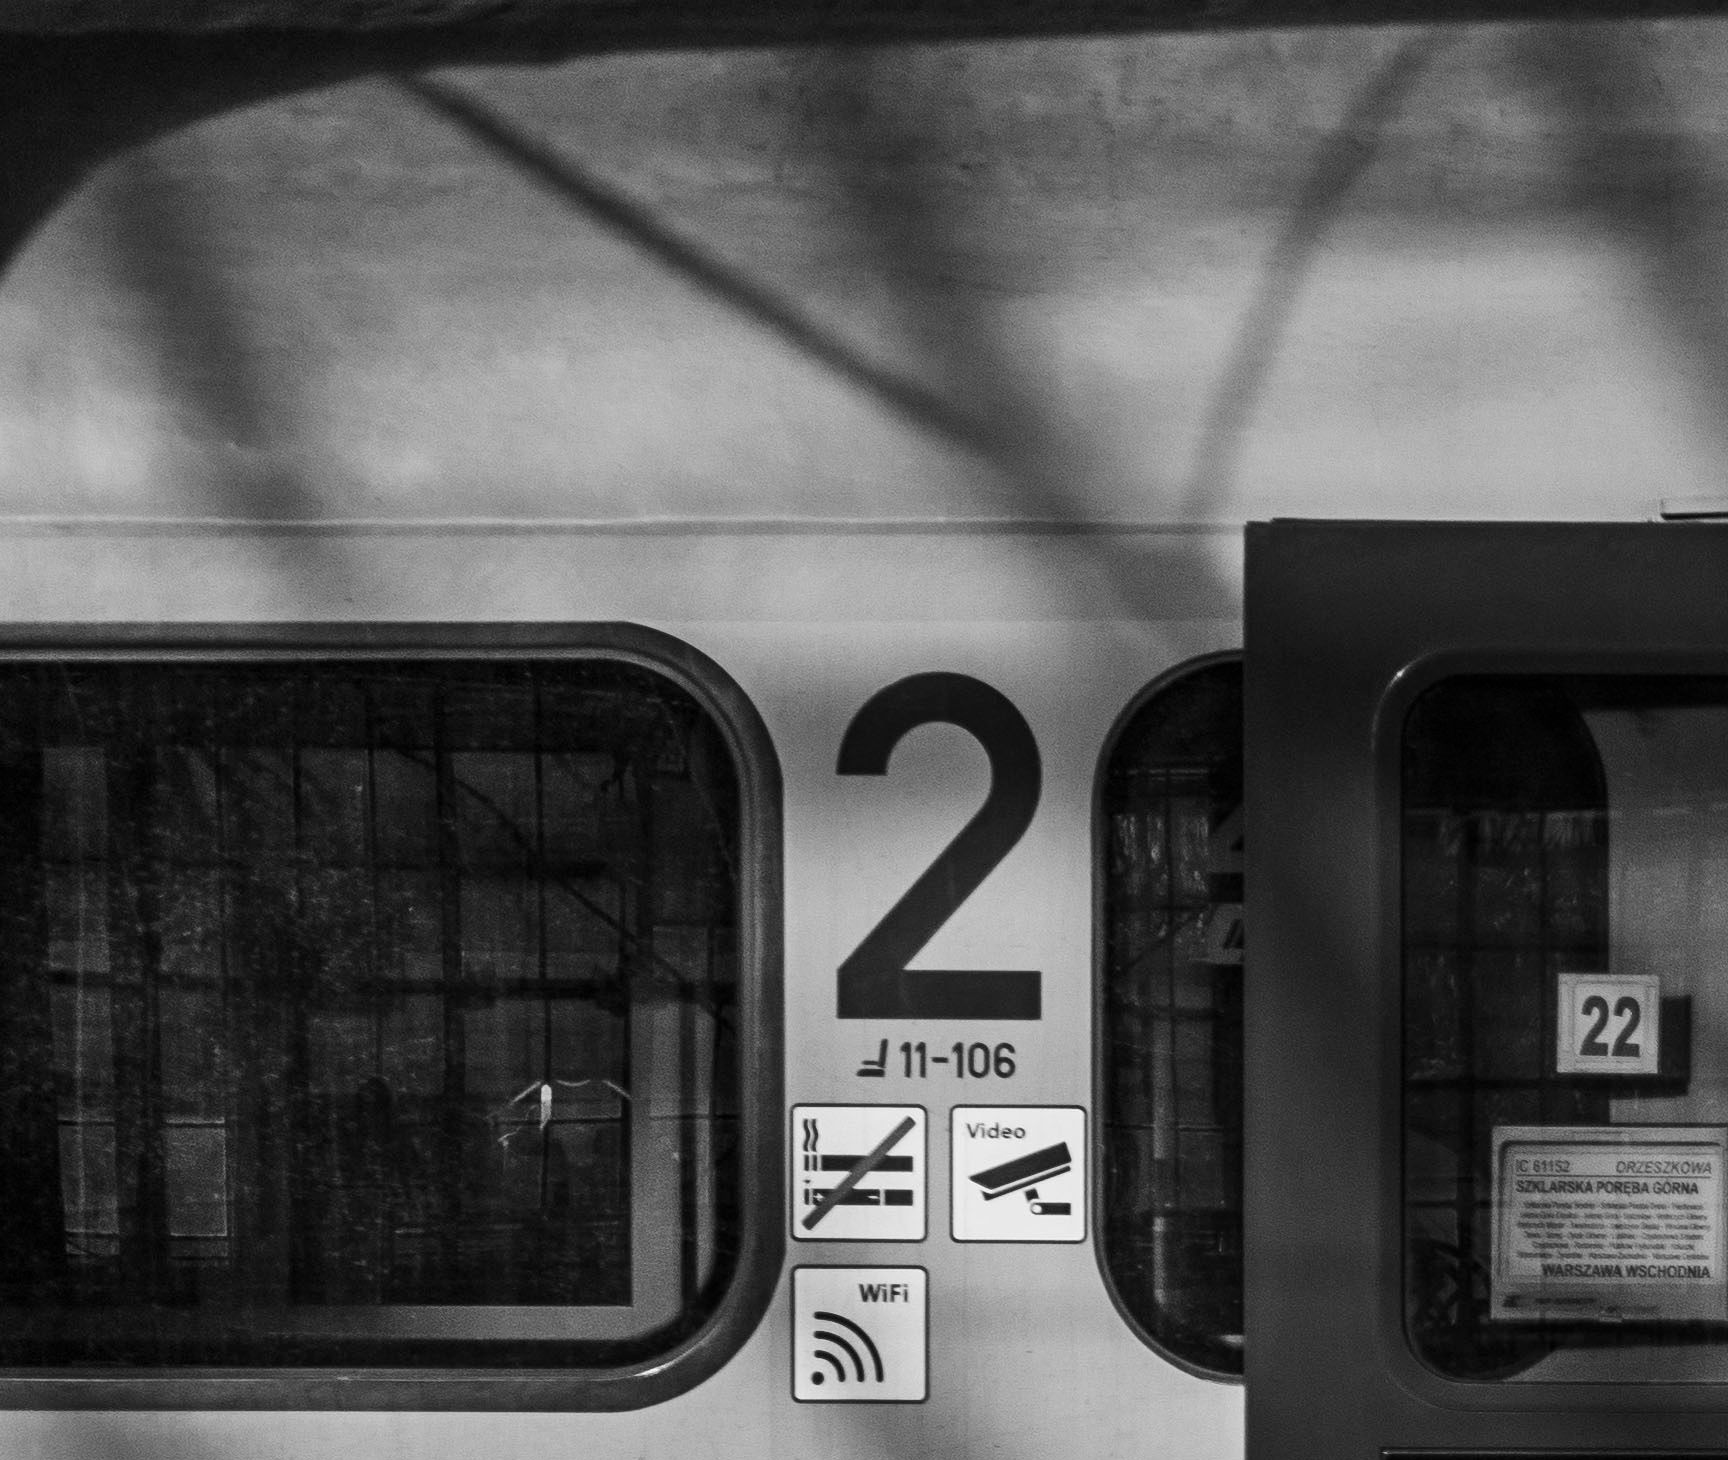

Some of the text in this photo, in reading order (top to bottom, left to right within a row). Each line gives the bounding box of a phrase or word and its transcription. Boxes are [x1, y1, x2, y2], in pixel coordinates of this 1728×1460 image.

[836, 671, 1042, 1020] 2
[1579, 995, 1641, 1058] 22
[900, 1041, 1017, 1079] 11-106
[966, 1122, 1027, 1140] Video
[1616, 1161, 1712, 1174] ORZESZKOWA
[1515, 1180, 1593, 1194] SZKLARSKA
[1542, 1264, 1711, 1279] WARSZAWA WSCHODNIA
[858, 1282, 909, 1304] WiFi
